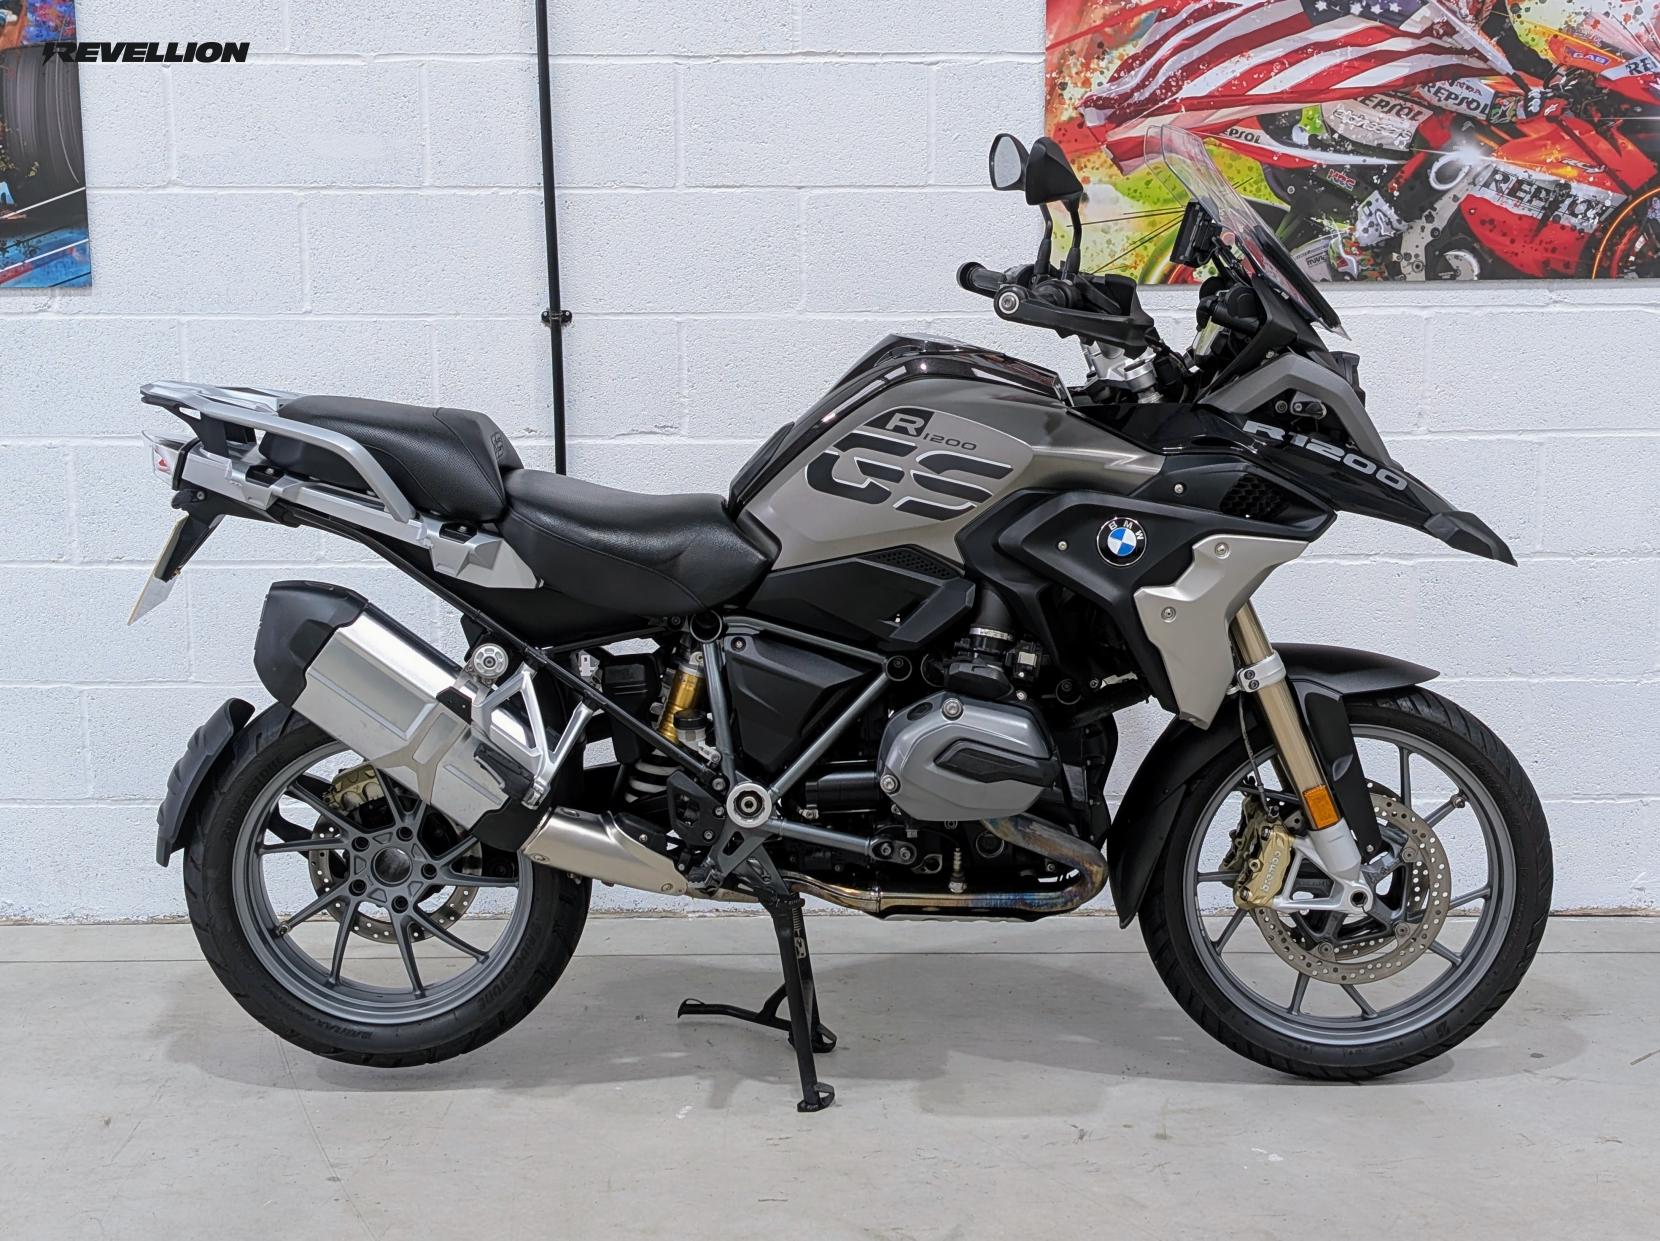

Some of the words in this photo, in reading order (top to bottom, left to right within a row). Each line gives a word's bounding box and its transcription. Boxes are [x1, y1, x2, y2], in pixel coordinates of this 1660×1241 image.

[1355, 93, 1424, 121] EPSOL
[1420, 81, 1491, 116] REPSOL
[885, 412, 925, 437] R
[923, 434, 977, 451] 1200
[804, 430, 1014, 521] GS
[1108, 520, 1144, 540] BMW
[1261, 851, 1281, 892] brembo
